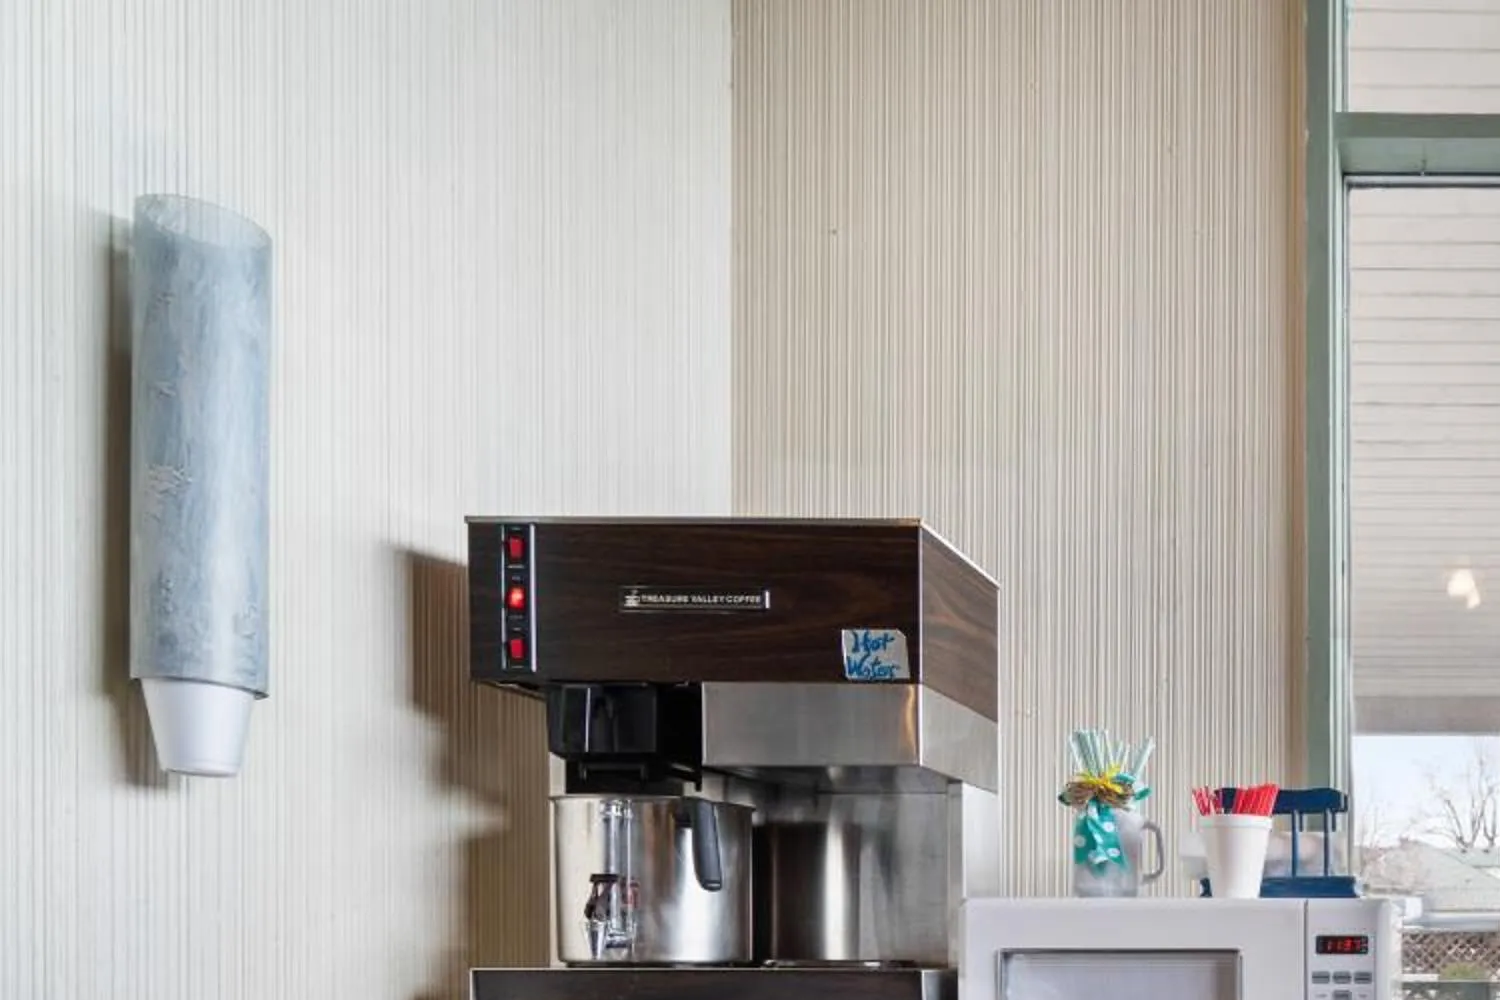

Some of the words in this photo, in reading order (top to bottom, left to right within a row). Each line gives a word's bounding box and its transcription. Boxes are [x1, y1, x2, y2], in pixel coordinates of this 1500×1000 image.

[640, 594, 689, 603] TREASURE
[691, 594, 725, 603] VALLEY
[726, 594, 761, 603] COFFEE
[851, 629, 895, 653] Hot
